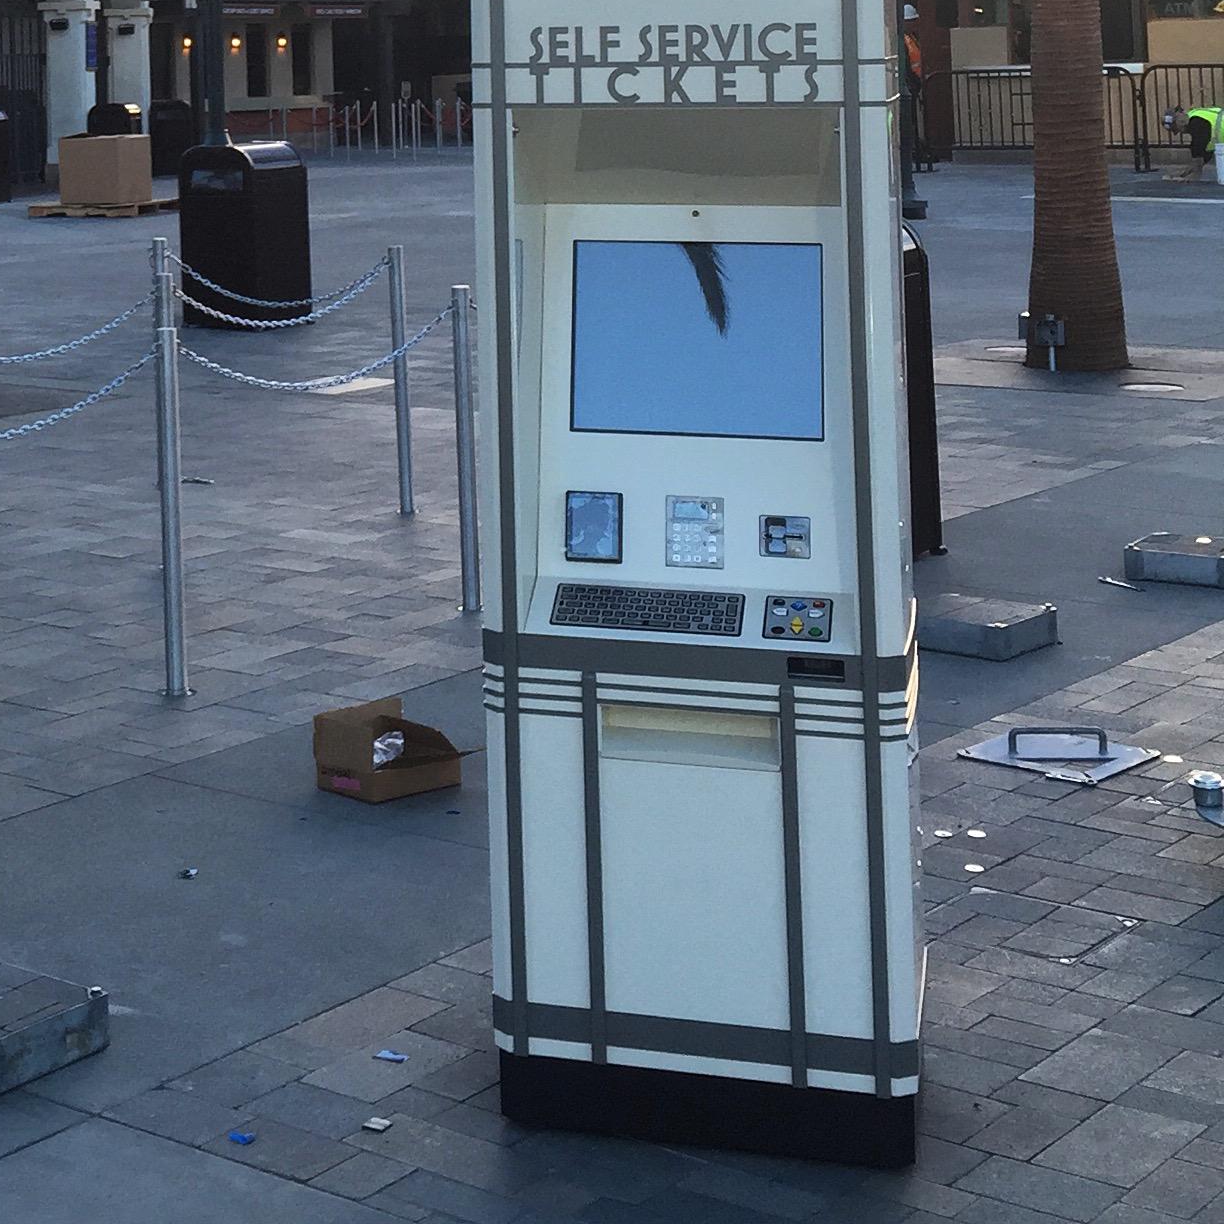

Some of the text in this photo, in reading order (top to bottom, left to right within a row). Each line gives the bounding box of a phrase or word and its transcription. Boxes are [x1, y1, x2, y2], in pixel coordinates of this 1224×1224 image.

[529, 22, 818, 64] SELF SERVICE
[529, 62, 819, 106] TICKETS
